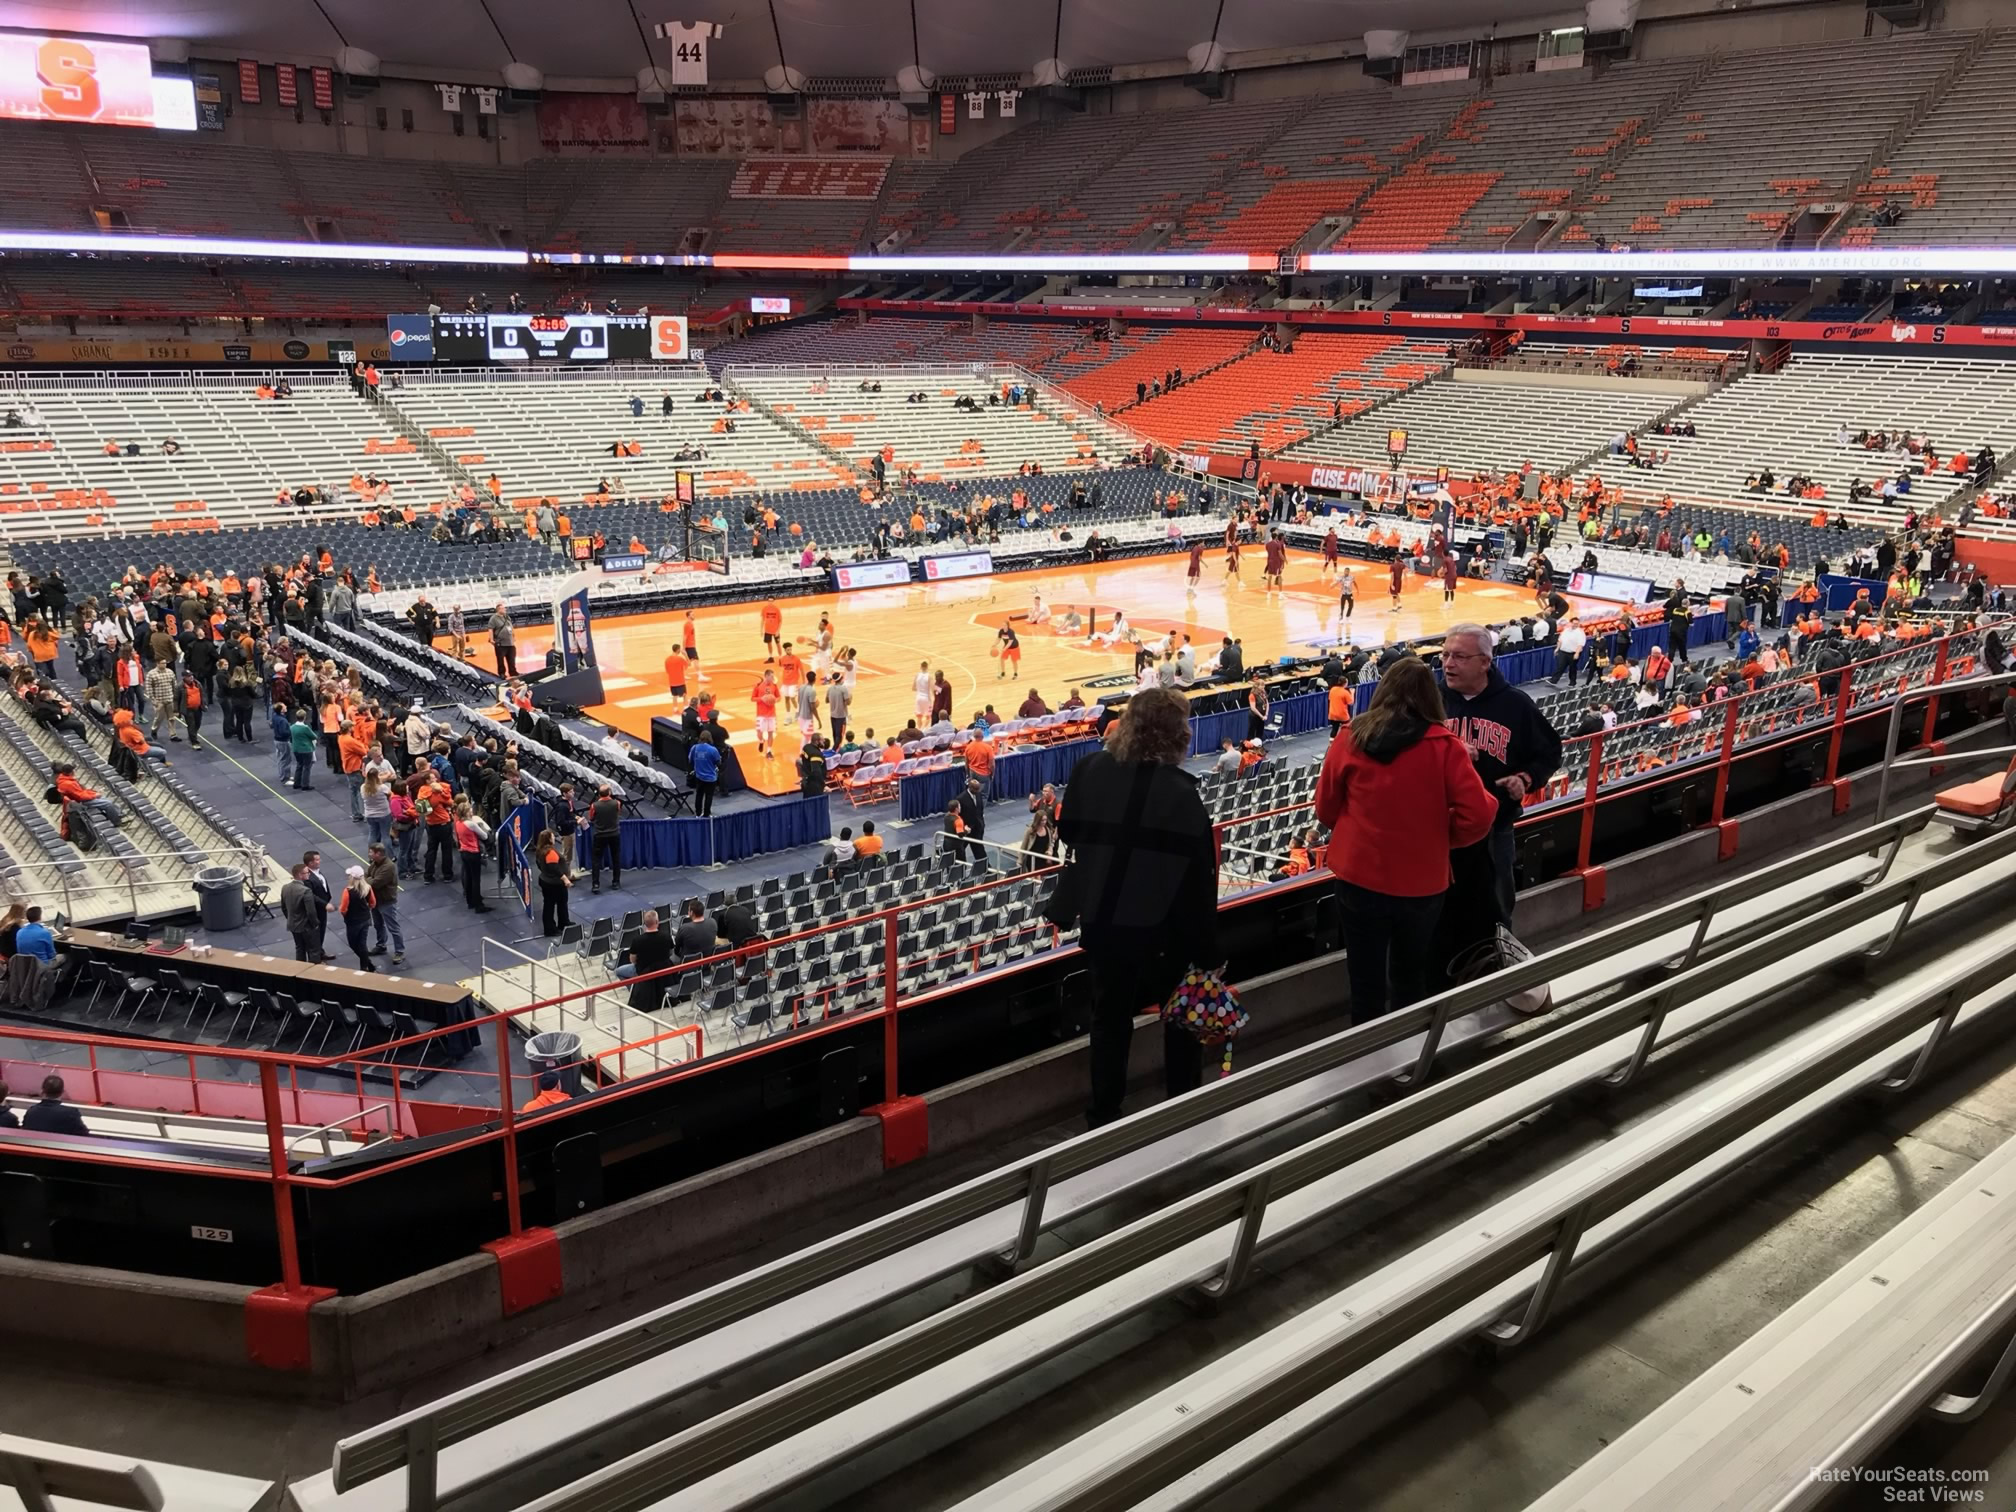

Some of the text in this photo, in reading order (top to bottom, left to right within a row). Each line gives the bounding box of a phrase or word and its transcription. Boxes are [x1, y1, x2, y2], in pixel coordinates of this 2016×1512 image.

[677, 43, 702, 62] 44
[37, 39, 104, 120] S
[972, 102, 982, 110] 88
[1003, 101, 1013, 109] 39
[200, 121, 223, 130] CROUSE
[562, 139, 600, 147] NATIONAL
[601, 139, 650, 147] CHAMPIONS
[1823, 204, 1836, 212] 303
[1489, 259, 1524, 269] EVERY
[1573, 258, 1597, 268] FOR
[1603, 258, 1642, 268] EVERY
[1717, 257, 1755, 267] VISIT
[1384, 313, 1391, 325] S
[1621, 319, 1630, 333] S
[1767, 327, 1780, 337] 103
[408, 333, 431, 342] pepsi
[504, 328, 593, 347] 0 0
[658, 320, 681, 355] S
[1851, 327, 1876, 339] ARMY
[1932, 327, 1946, 343] S
[71, 346, 113, 360] SARANAC
[149, 347, 191, 359] 1911
[341, 352, 355, 362] 123
[1245, 461, 1257, 478] S
[614, 559, 643, 568] DELTA
[926, 561, 938, 577] S
[838, 569, 851, 587] S
[165, 613, 178, 636] S
[1443, 716, 1511, 765] RACUSE
[198, 1228, 229, 1240] 129
